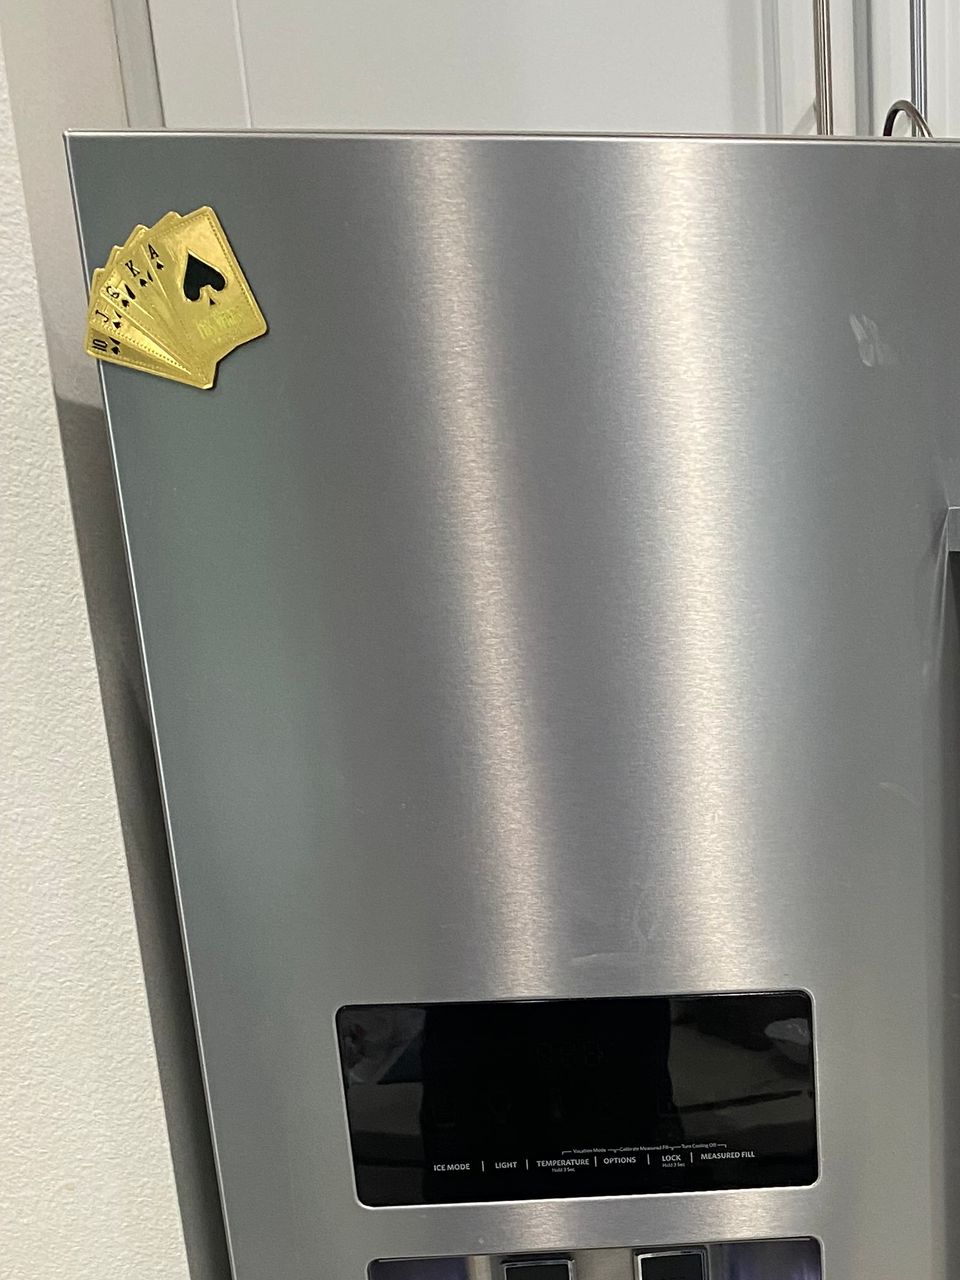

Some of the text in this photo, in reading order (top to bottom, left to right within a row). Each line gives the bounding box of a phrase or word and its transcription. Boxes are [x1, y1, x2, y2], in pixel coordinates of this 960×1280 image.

[125, 259, 141, 278] K
[662, 1154, 682, 1162] LOCK
[700, 1150, 755, 1160] MEASURED FILL
[495, 1161, 517, 1169] LIGHT
[536, 1158, 590, 1167] TEMPERATURE
[603, 1156, 637, 1165] OPTIONS
[433, 1163, 470, 1172] ICE MODE
